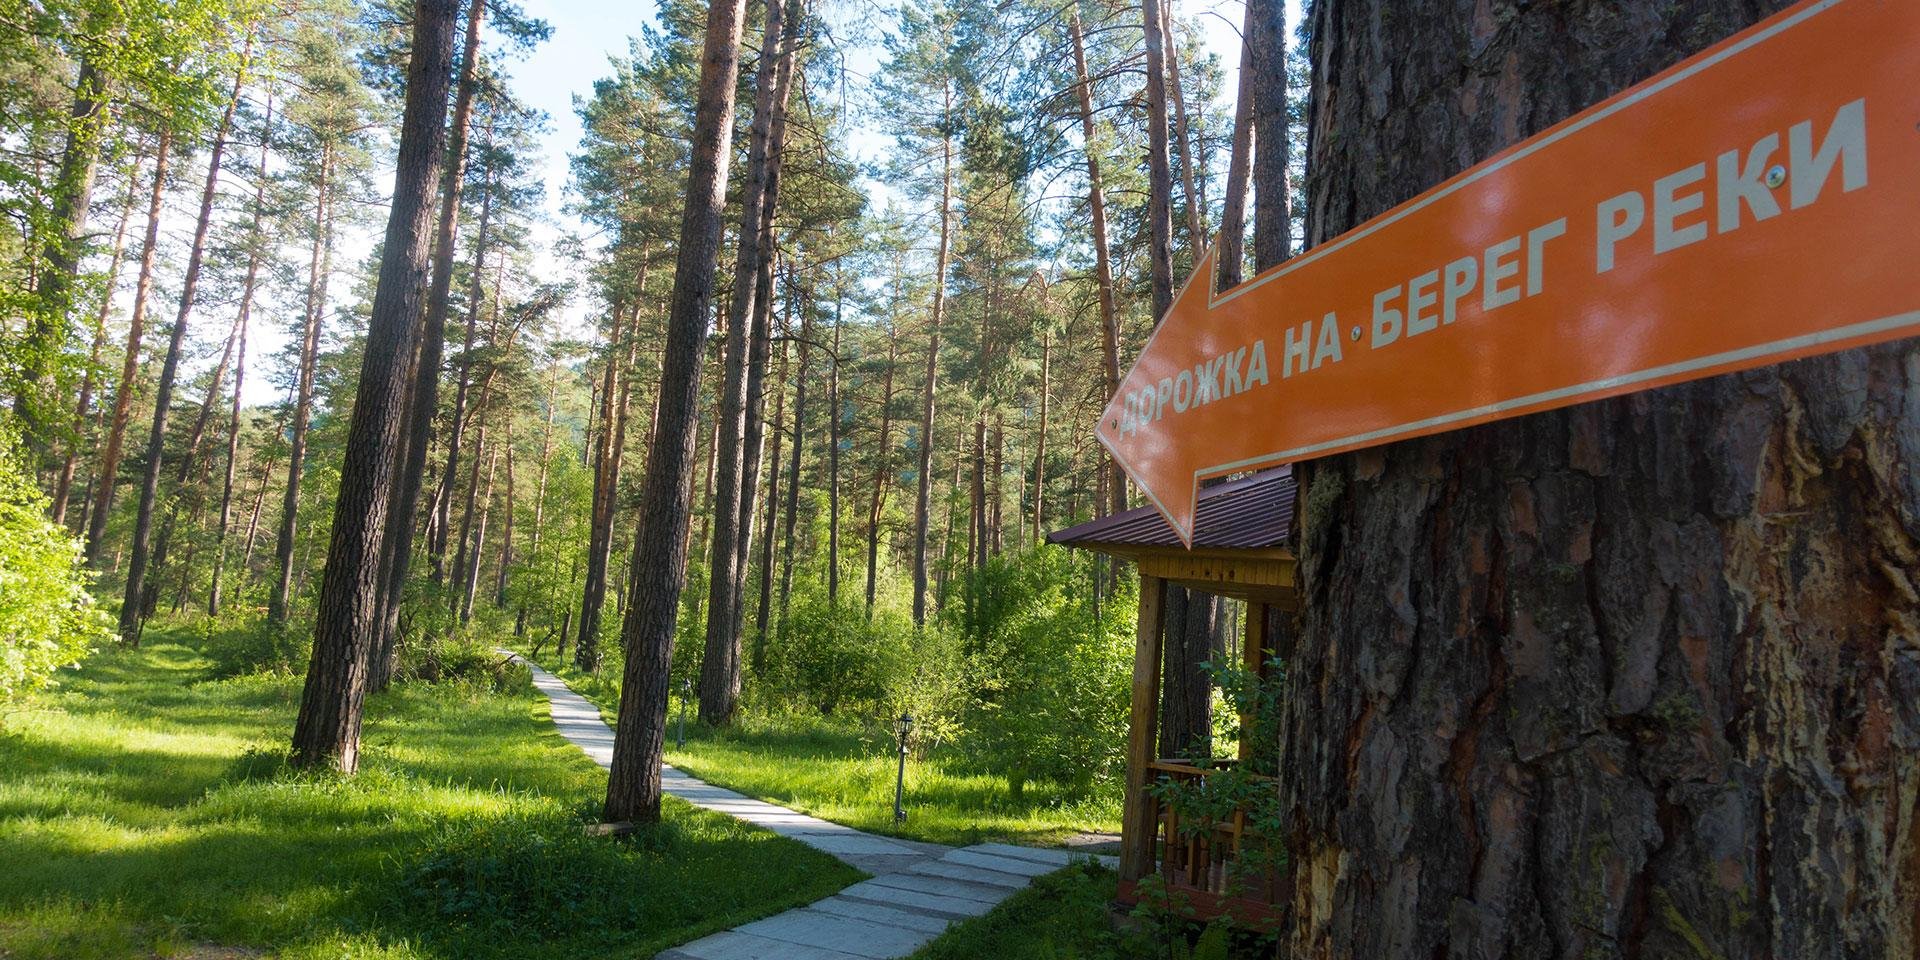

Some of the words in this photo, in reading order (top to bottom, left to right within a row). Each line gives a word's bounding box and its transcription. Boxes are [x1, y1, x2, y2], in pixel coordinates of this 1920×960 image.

[1119, 339, 1269, 441] ДОРОЖКА
[1282, 311, 1343, 379] НА
[1371, 216, 1567, 350] БЕРЕГ
[1596, 97, 1868, 275] РЕКИ
